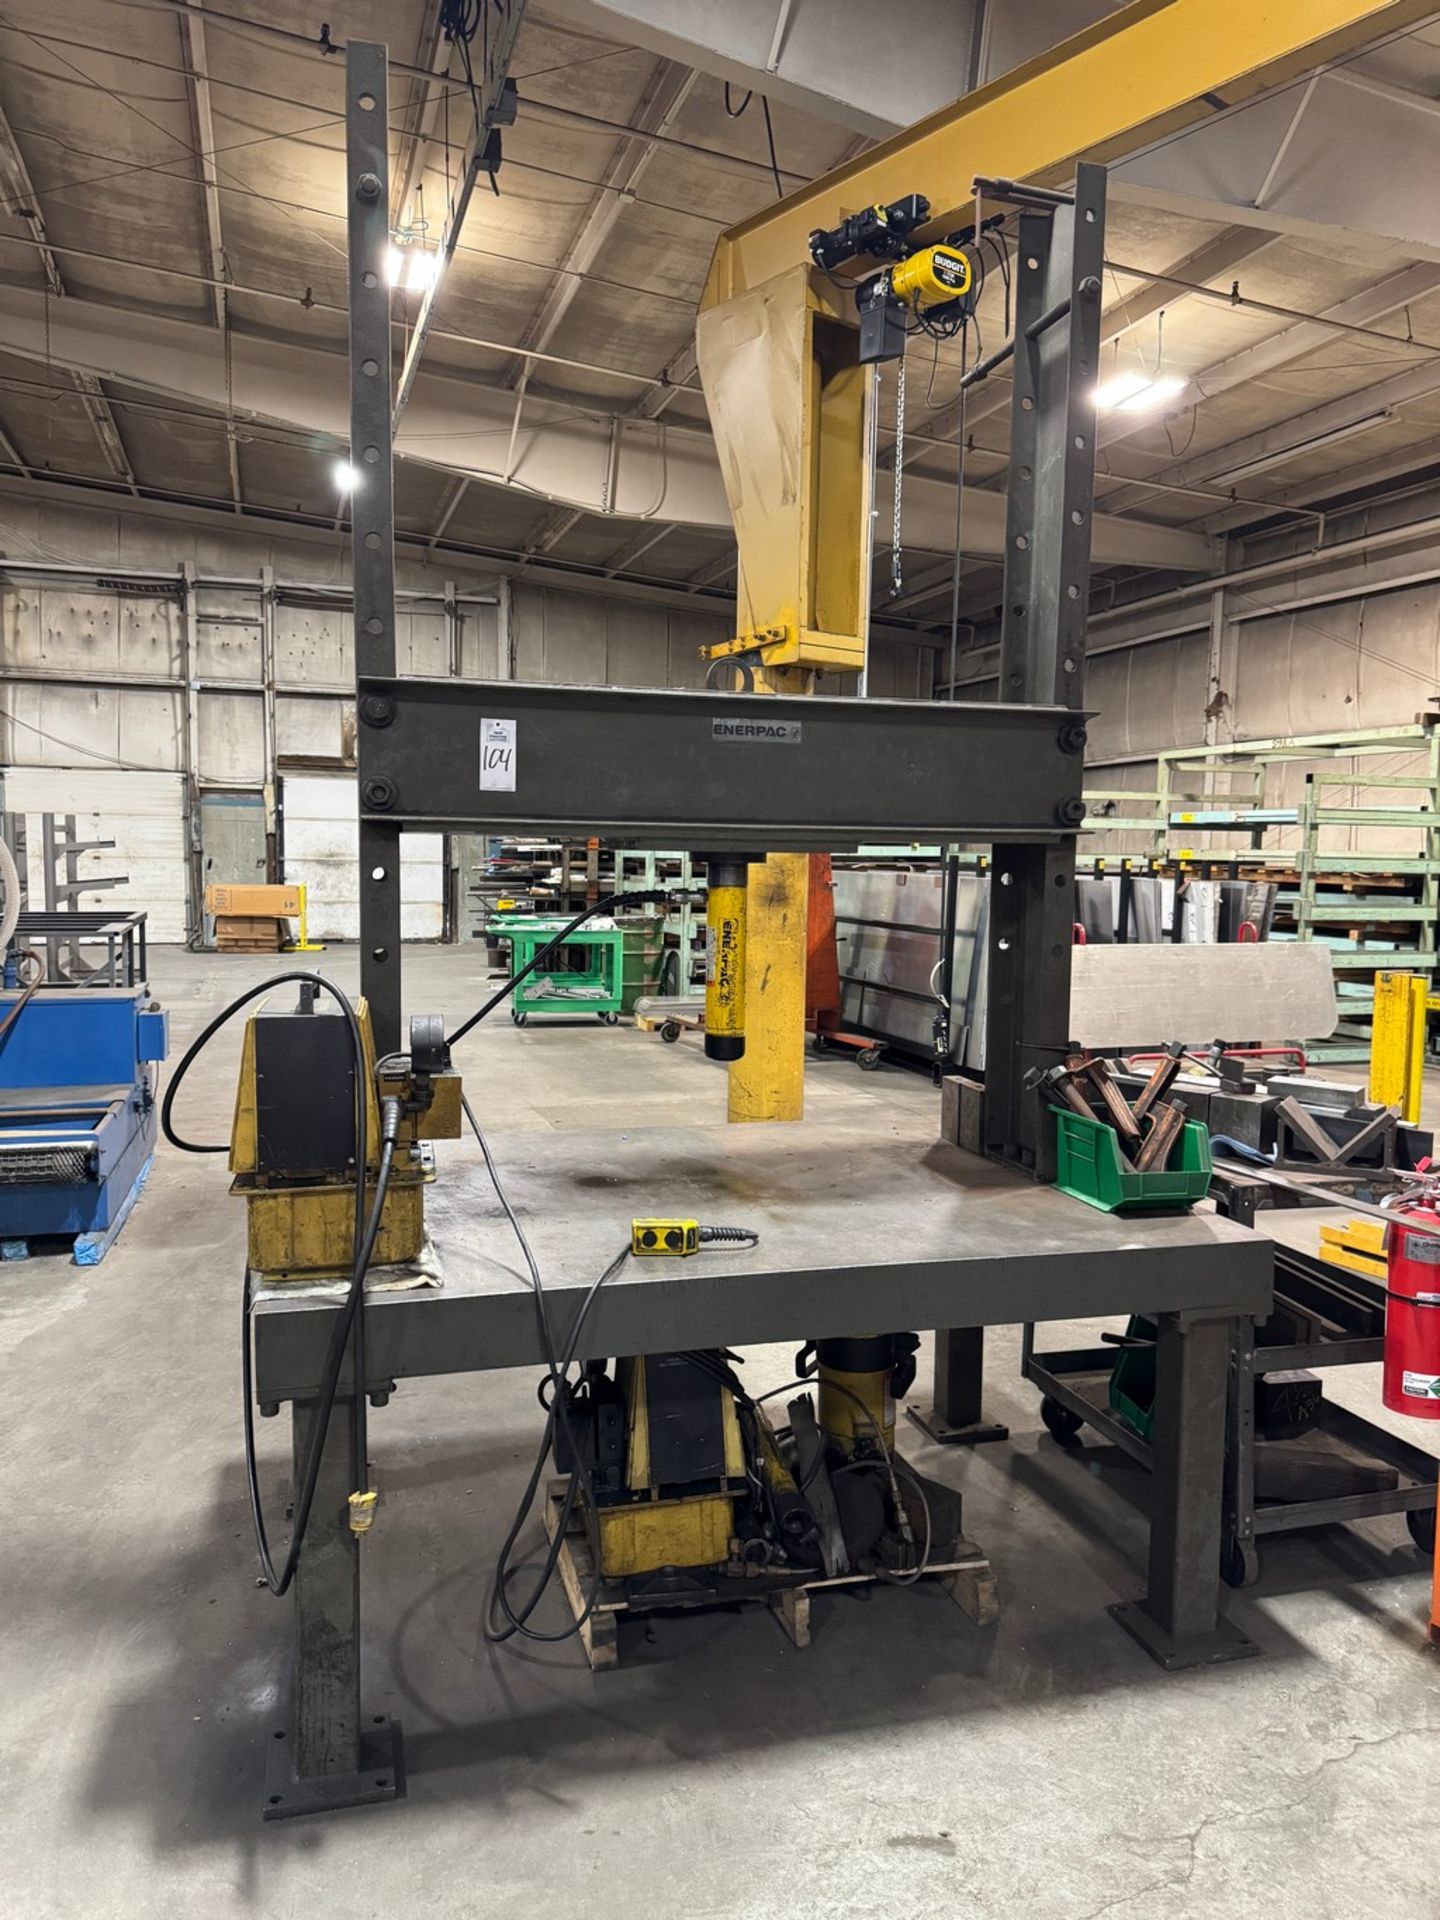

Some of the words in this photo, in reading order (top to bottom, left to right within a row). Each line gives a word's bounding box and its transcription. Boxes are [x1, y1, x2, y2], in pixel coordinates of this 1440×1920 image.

[934, 254, 966, 274] BUDGIT
[713, 724, 787, 737] ENERPAC
[483, 745, 513, 772] 104
